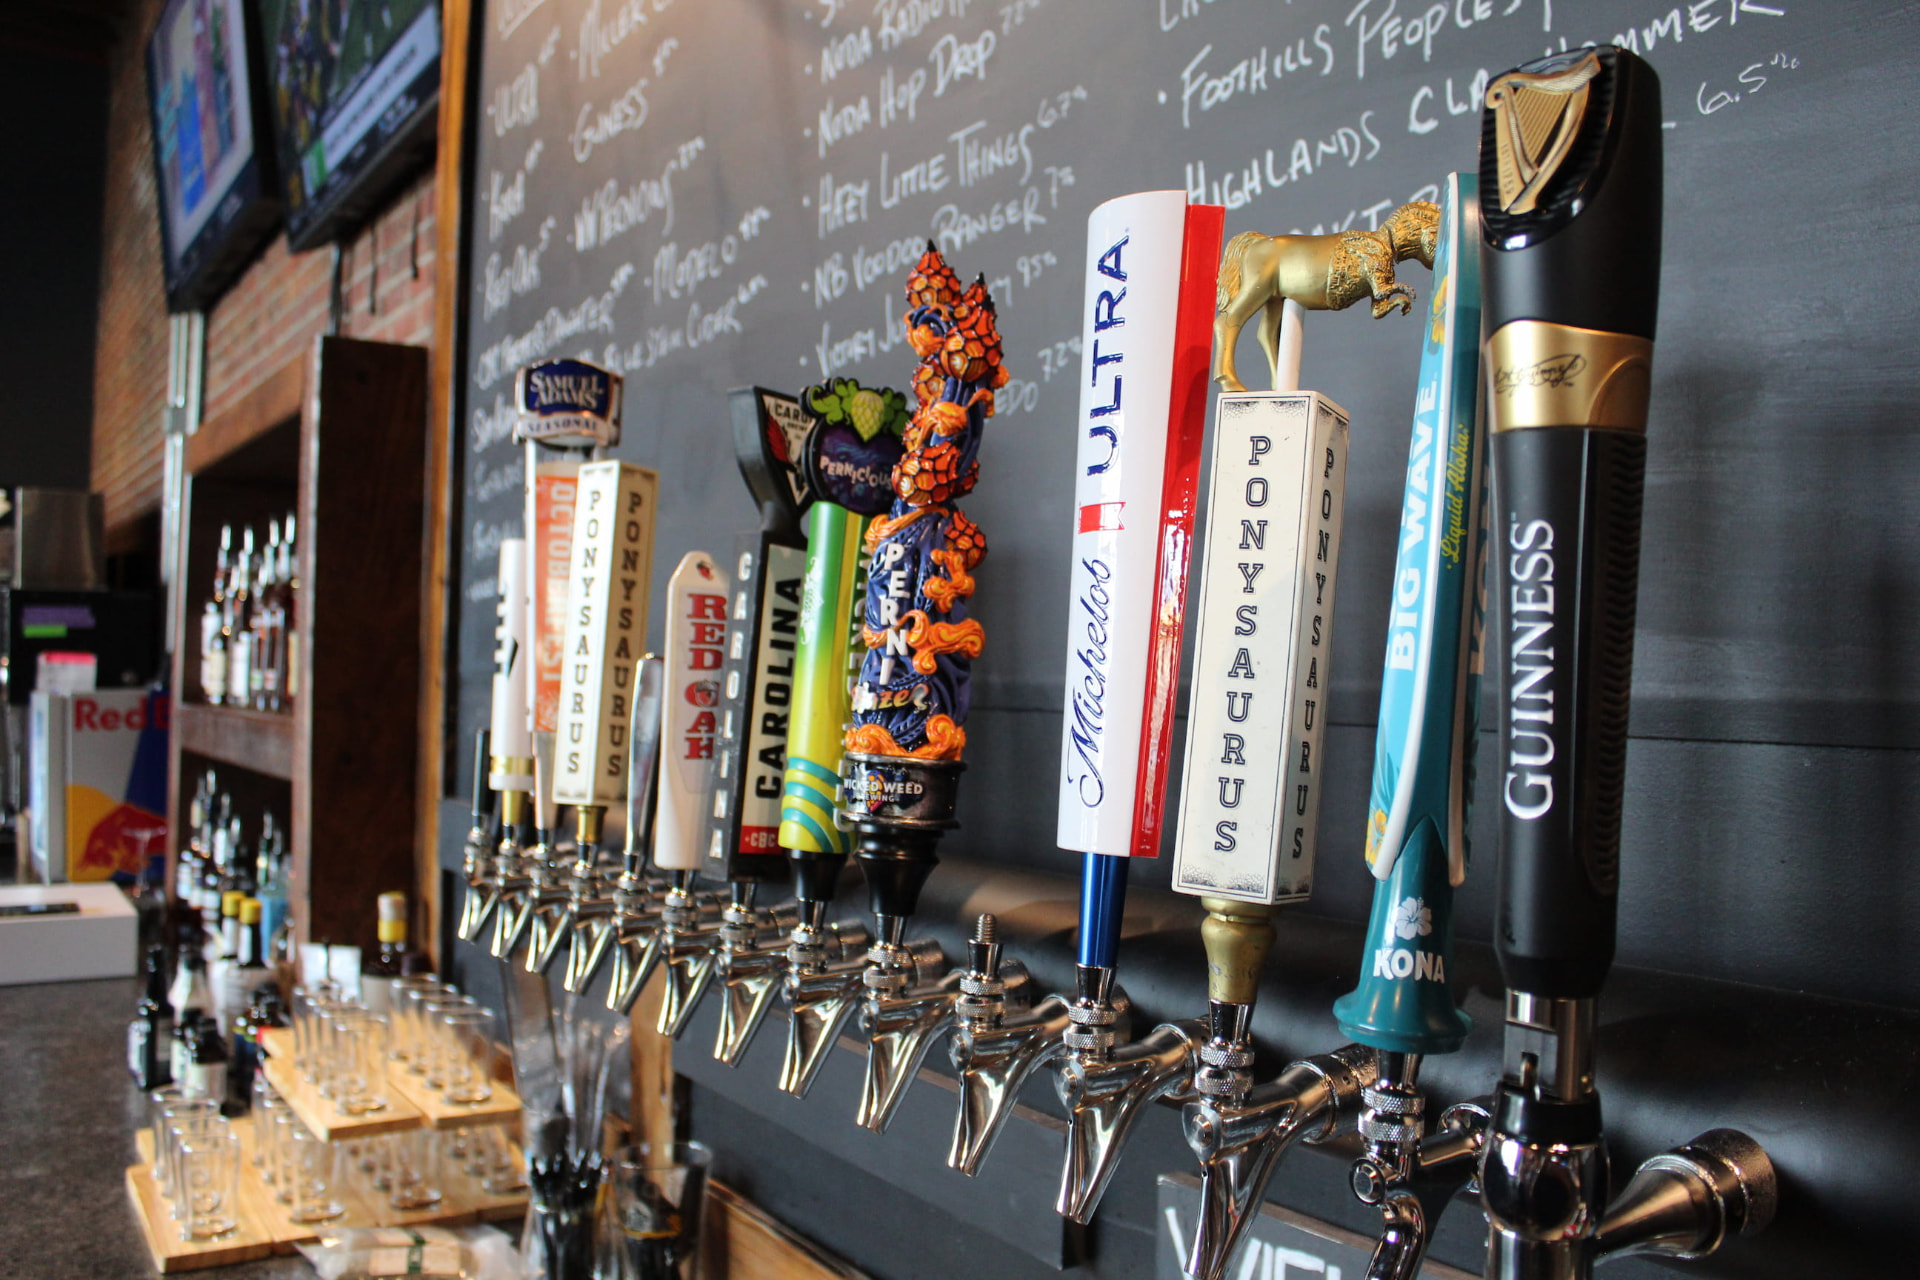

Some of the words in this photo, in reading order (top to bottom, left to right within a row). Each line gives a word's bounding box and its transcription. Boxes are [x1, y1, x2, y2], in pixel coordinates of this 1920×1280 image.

[879, 65, 926, 129] HOP
[928, 29, 996, 98] DROP
[1180, 43, 1334, 129] FOOTHILLS
[1344, 0, 1521, 80] PEOPLE
[948, 119, 1036, 188] THINGS
[1185, 110, 1381, 210] HIGHLANDS
[530, 371, 604, 395] SAMUEL
[534, 386, 598, 411] ADAMS
[1086, 234, 1130, 477] ULTRA
[1401, 380, 1437, 555] WAVE
[566, 489, 601, 774] PONYSAURUS
[607, 491, 643, 778] PONYSAURUS
[686, 592, 728, 671] RED
[1067, 556, 1112, 809] Michelob
[1214, 435, 1272, 853] PONYSAURUS
[1292, 447, 1335, 860] PONYSAURUS
[1388, 566, 1421, 672] BIG
[1503, 518, 1556, 821] GUINNESS
[73, 697, 147, 731] Red
[709, 552, 753, 859] CAROLINA
[755, 577, 803, 800] CAROLINA
[883, 781, 924, 795] WEED
[1373, 948, 1446, 985] KONA
